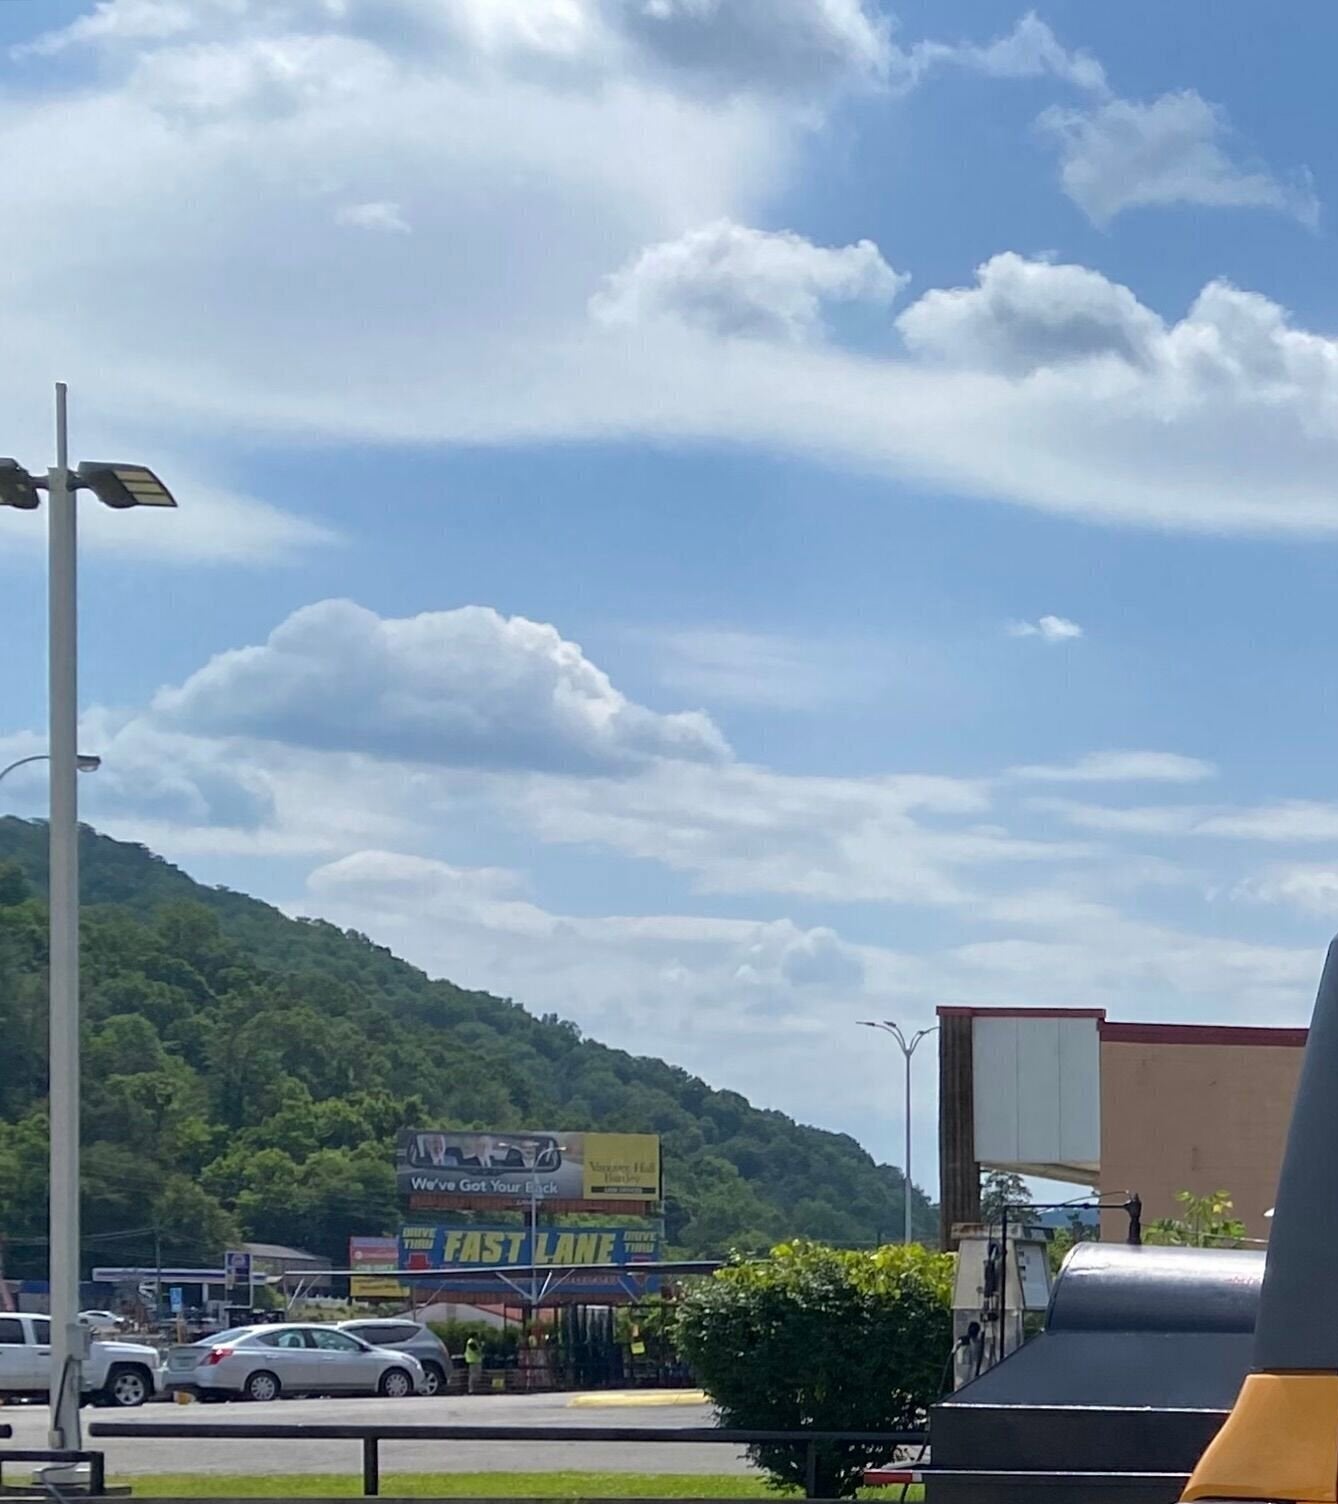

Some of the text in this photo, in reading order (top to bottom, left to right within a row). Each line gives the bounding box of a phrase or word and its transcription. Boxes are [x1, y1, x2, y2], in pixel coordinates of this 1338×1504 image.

[411, 1176, 455, 1192] We've
[459, 1178, 488, 1193] Got
[489, 1178, 520, 1194] Your
[402, 1227, 438, 1238] DRIVE
[624, 1230, 658, 1241] DRIVE
[403, 1239, 434, 1250] THRU
[443, 1229, 617, 1264] FAST LANE
[624, 1242, 655, 1253] THRU
